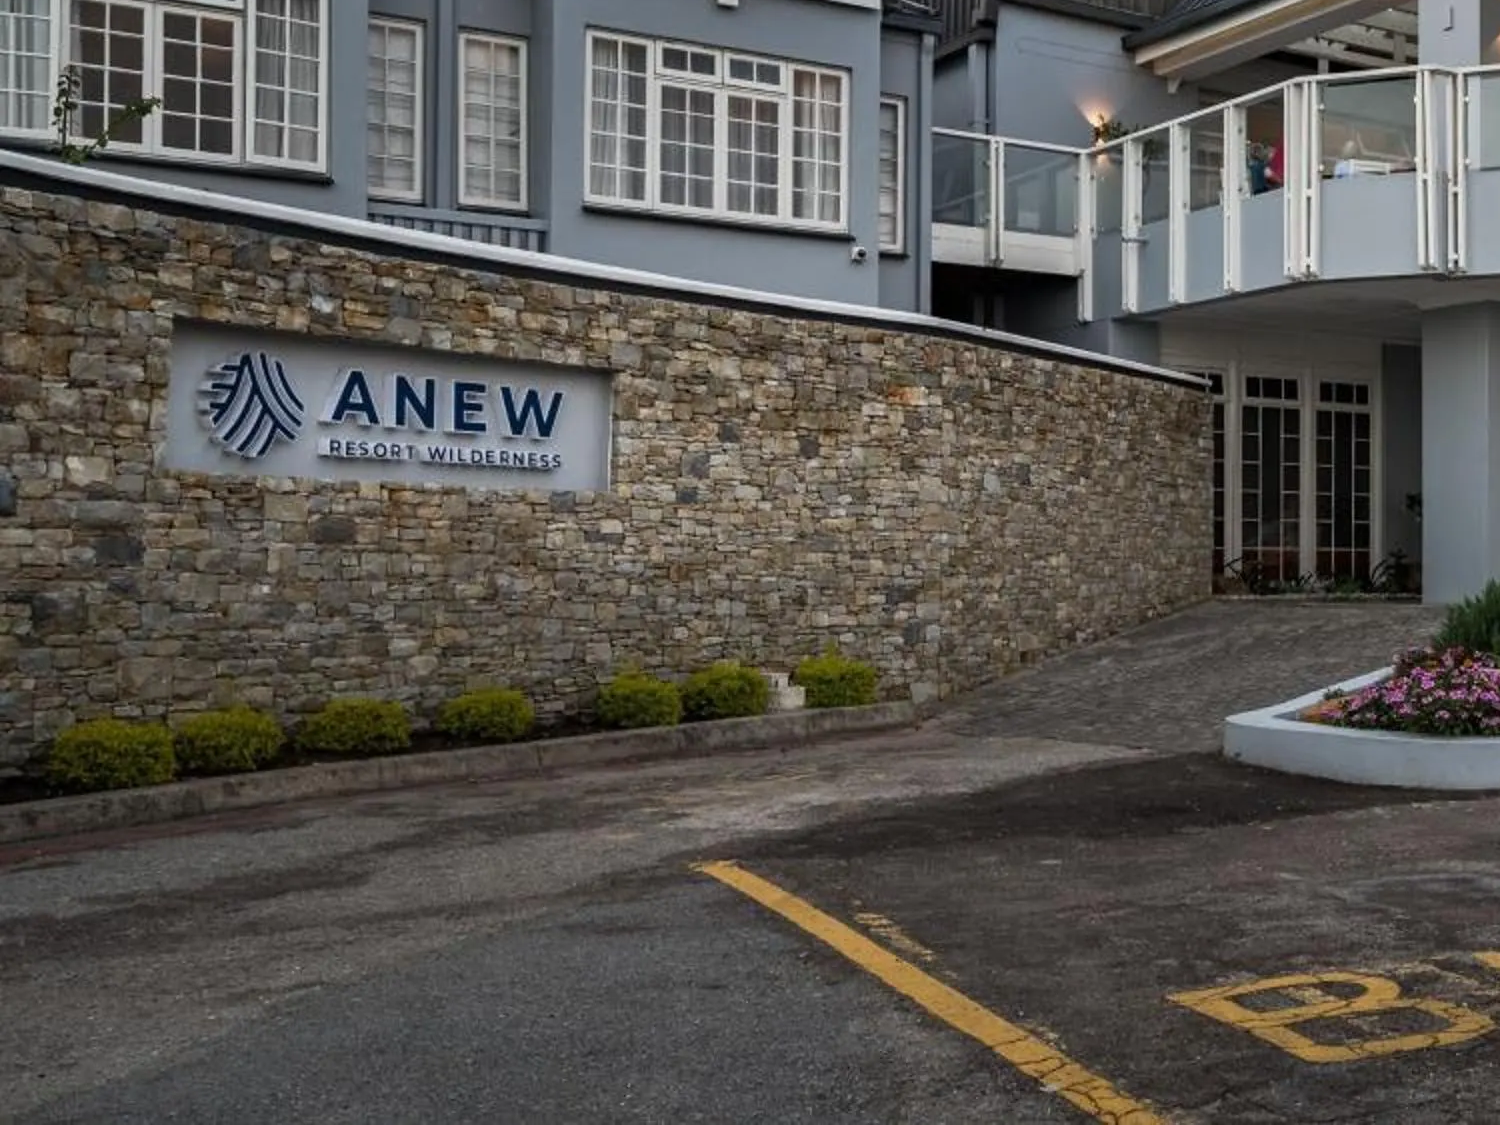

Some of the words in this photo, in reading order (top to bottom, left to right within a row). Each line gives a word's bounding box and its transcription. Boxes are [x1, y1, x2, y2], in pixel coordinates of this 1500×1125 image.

[331, 370, 563, 437] ANEW
[329, 439, 415, 460] RESORT
[429, 446, 562, 468] WILDERNESS
